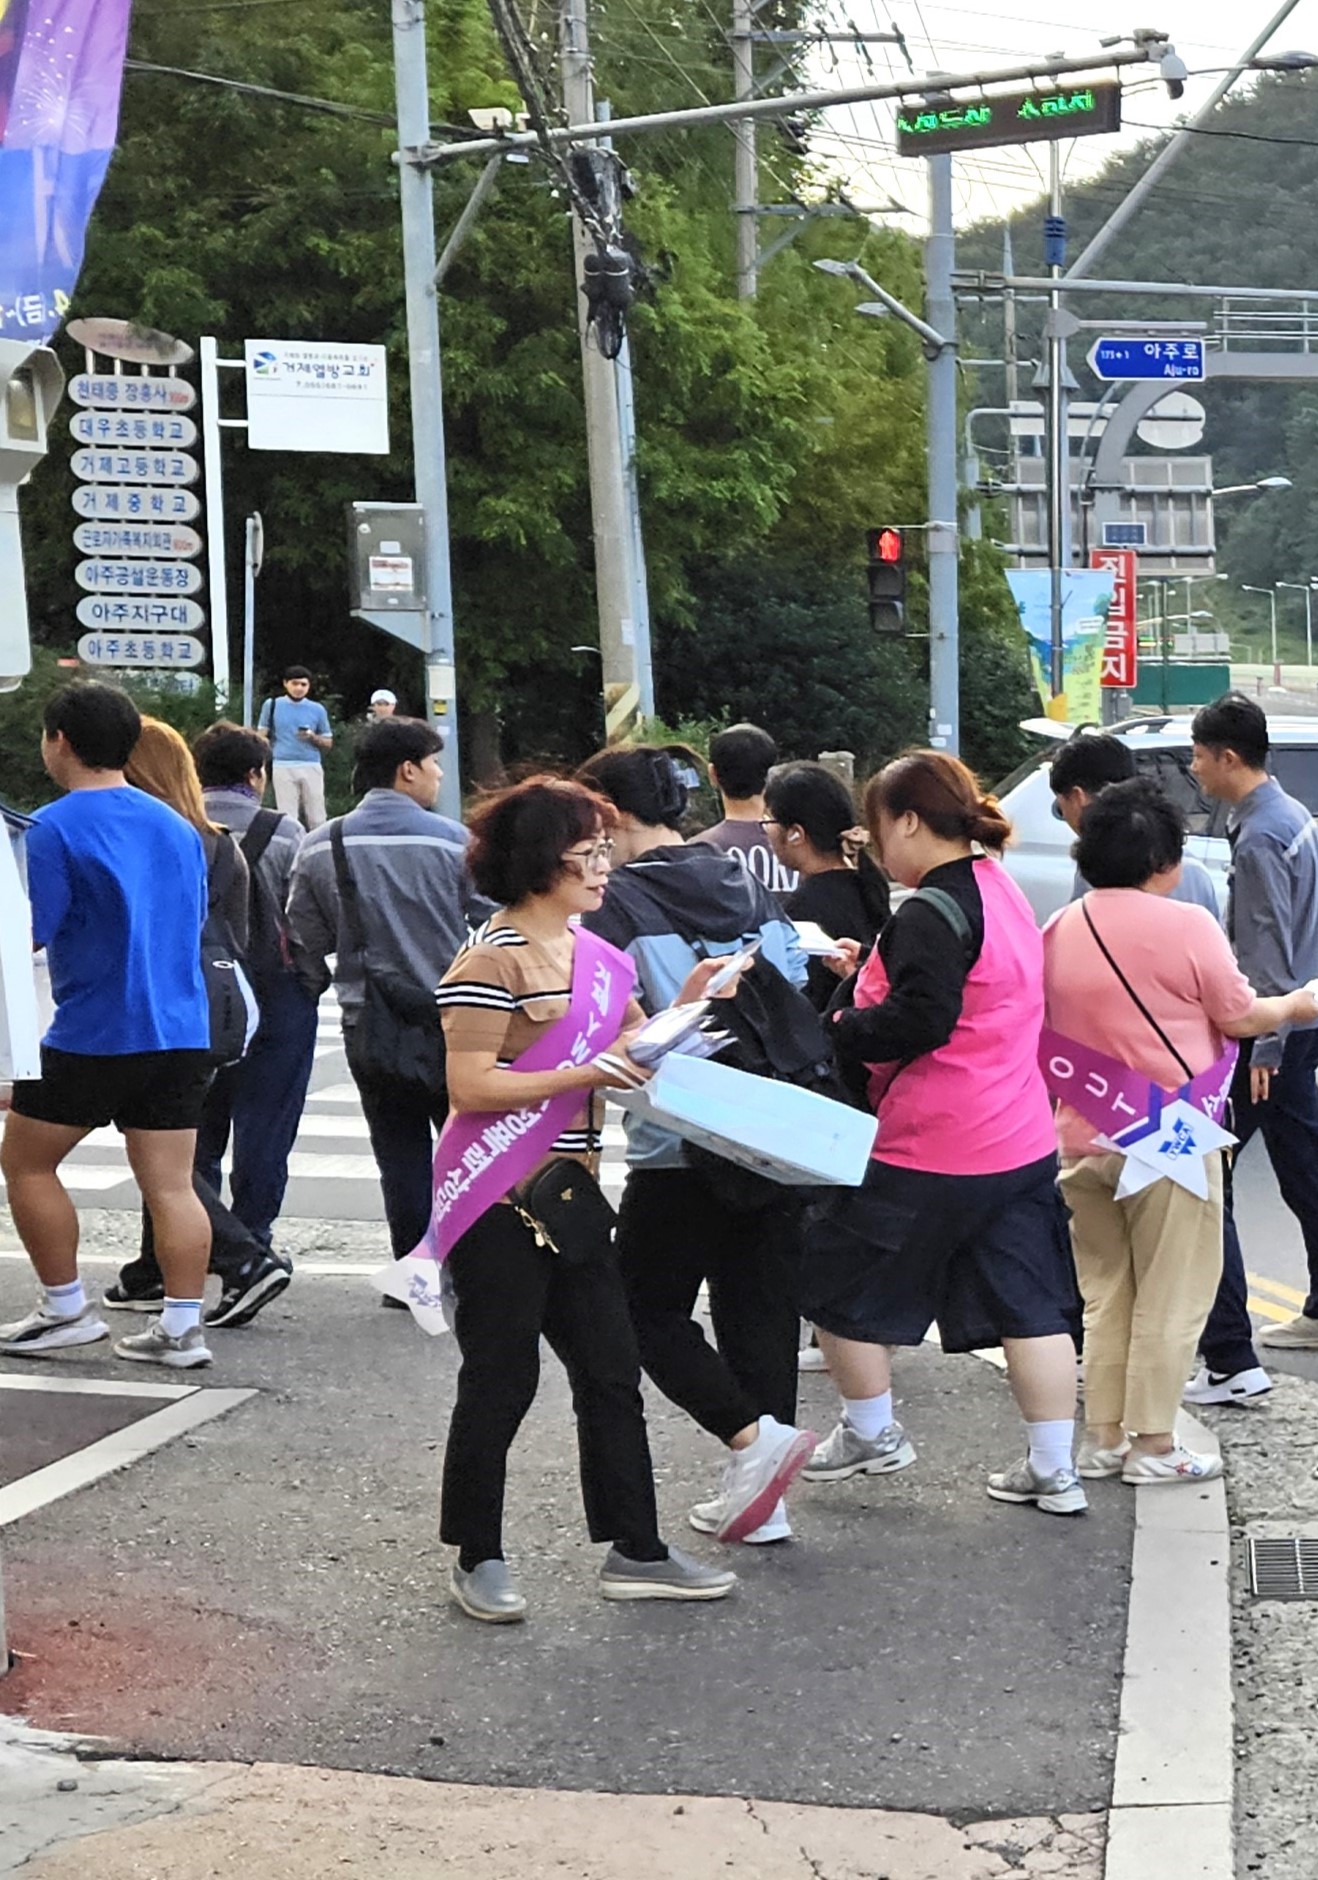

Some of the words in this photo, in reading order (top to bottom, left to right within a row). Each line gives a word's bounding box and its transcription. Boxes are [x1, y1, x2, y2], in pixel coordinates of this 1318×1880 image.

[1144, 343, 1199, 360] 아주로
[282, 362, 370, 379] 거제열방교회
[1164, 364, 1199, 377] Aju-ro
[80, 418, 183, 440] 대우초등학교
[81, 455, 185, 477] 거제고등학교
[83, 492, 186, 513] 거제중학교
[85, 564, 188, 588] 아주공설운동장
[92, 602, 187, 623] 아주지구대
[88, 639, 191, 660] 아주초등학교
[1049, 1056, 1137, 1117] OUT
